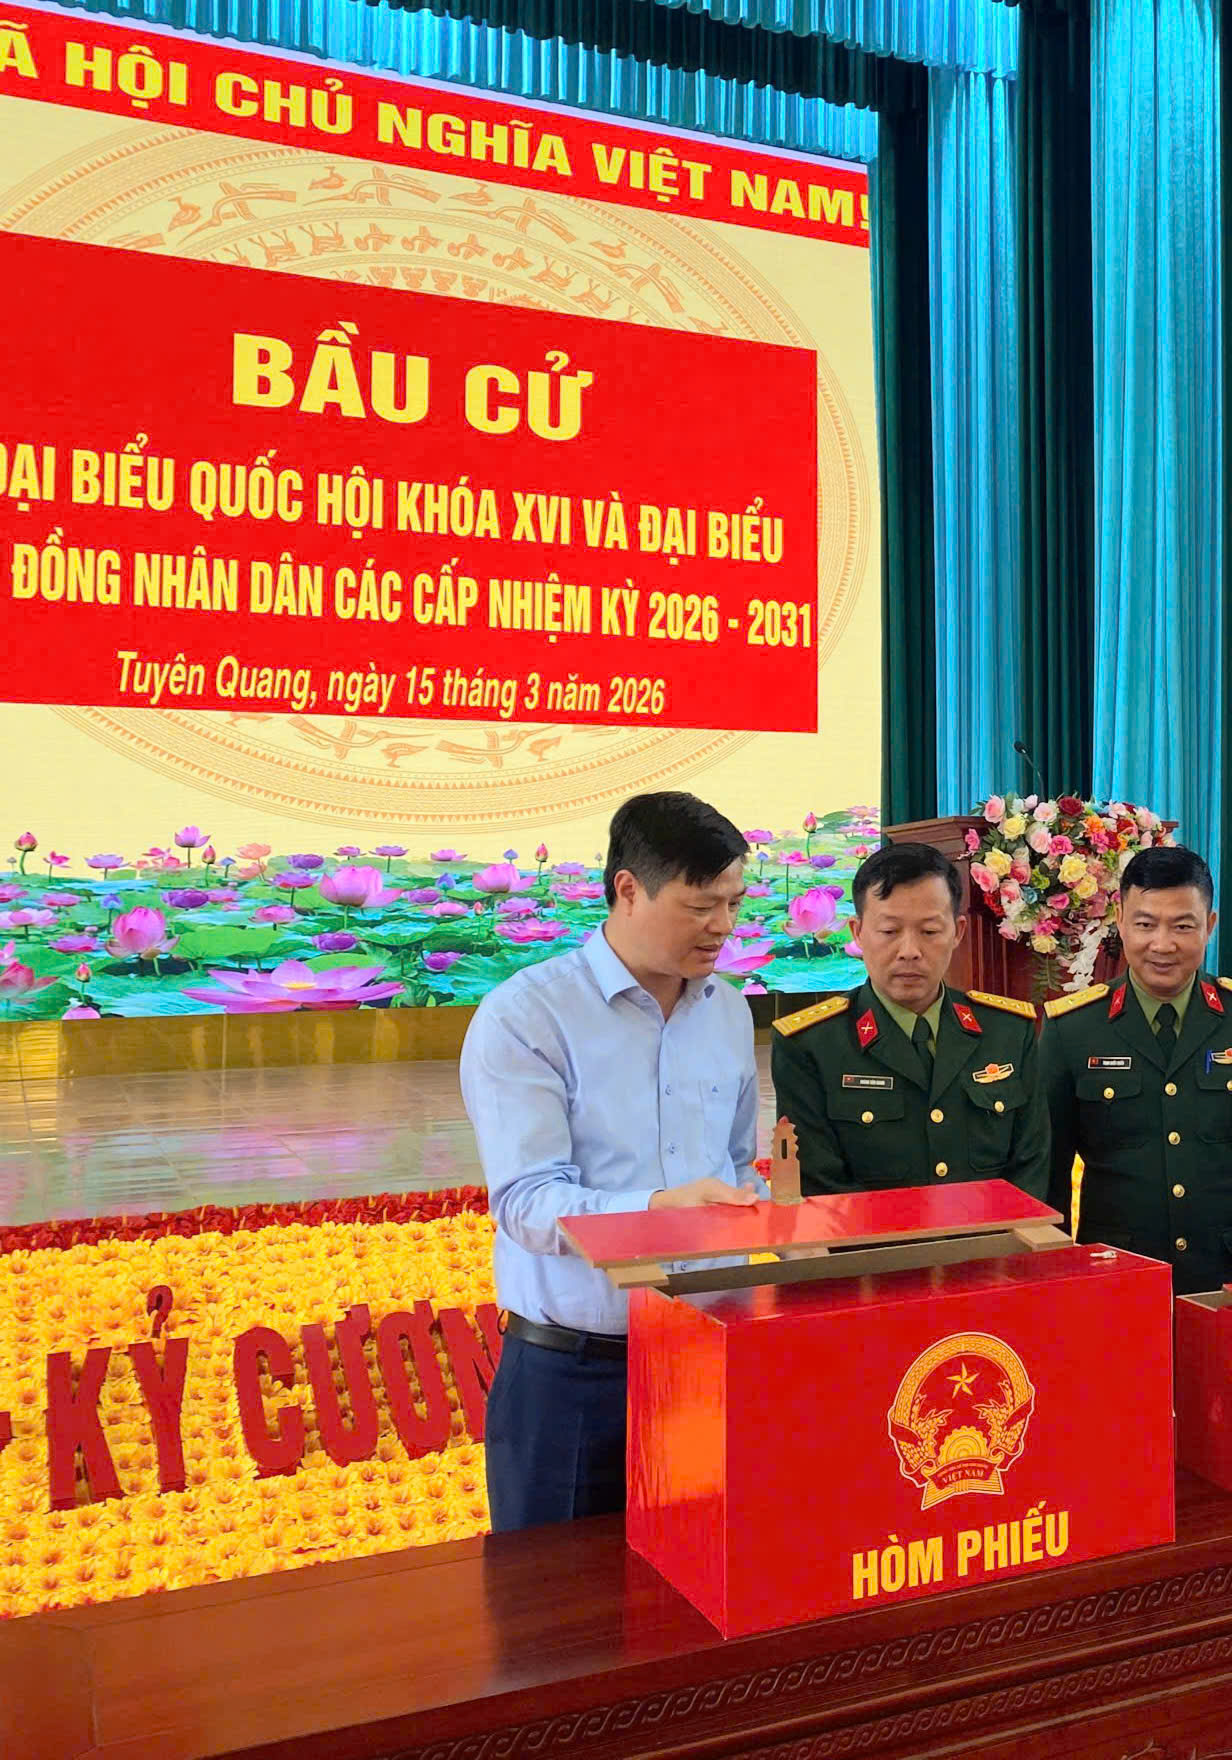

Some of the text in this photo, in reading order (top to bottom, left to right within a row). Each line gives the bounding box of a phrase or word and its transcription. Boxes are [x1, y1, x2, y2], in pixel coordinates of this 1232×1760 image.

[65, 43, 188, 109] HỘI
[215, 72, 353, 135] CHỦ
[378, 102, 573, 176] NGHĨA
[591, 143, 712, 203] VIỆT
[730, 170, 870, 230] NAM!
[232, 321, 593, 441] BẦU CỬ
[0, 432, 784, 565] ẠI BIỂU QUỐC HỘI KHÓA XVI VÀ ĐẠI BIỂU
[11, 527, 812, 647] ĐỒNG NHÂN DÂN CÁC CẤP NHIỆM KỲ 2026 - 2031
[118, 650, 665, 718] Tuyên Quang, ngày 15 tháng 3 năm 2026
[44, 1285, 189, 1511] KỶ
[853, 1500, 1069, 1599] HÒM PHIẾU
